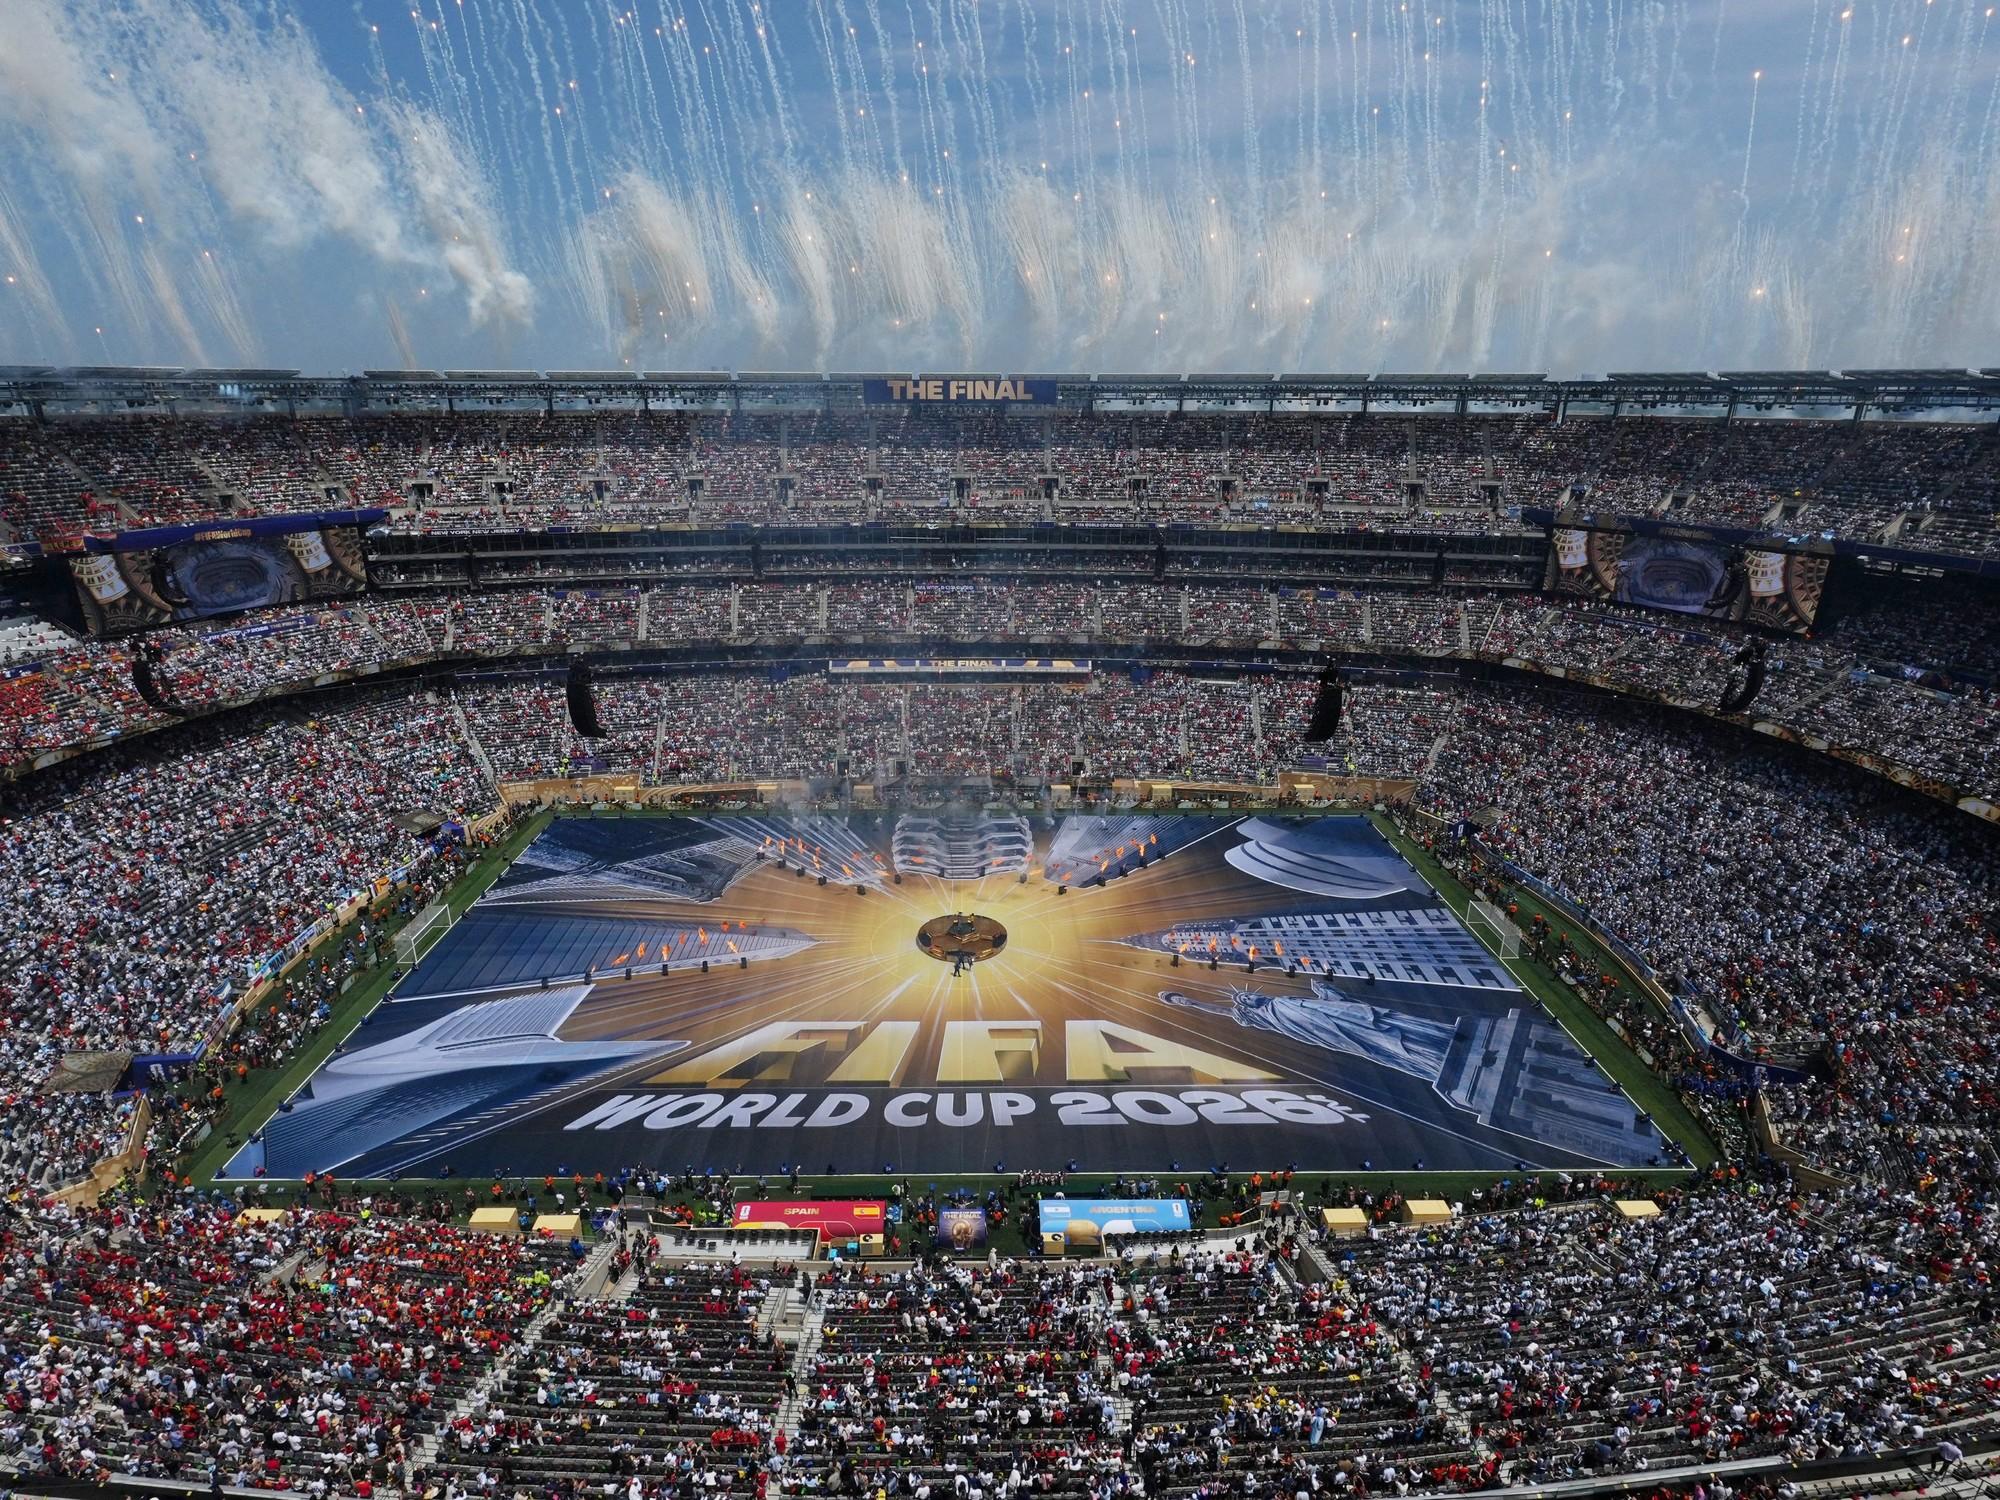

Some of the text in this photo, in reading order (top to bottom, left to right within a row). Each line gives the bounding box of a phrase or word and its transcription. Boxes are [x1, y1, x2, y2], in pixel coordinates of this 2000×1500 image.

[887, 380, 1033, 400] THE FINAL
[929, 660, 996, 668] THE FINAL
[640, 1020, 1290, 1088] FIFA
[563, 1093, 870, 1130] WORLD
[884, 1092, 1036, 1127] CUP
[784, 1207, 820, 1215] SPAIN
[1089, 1206, 1157, 1214] ARGENTINA
